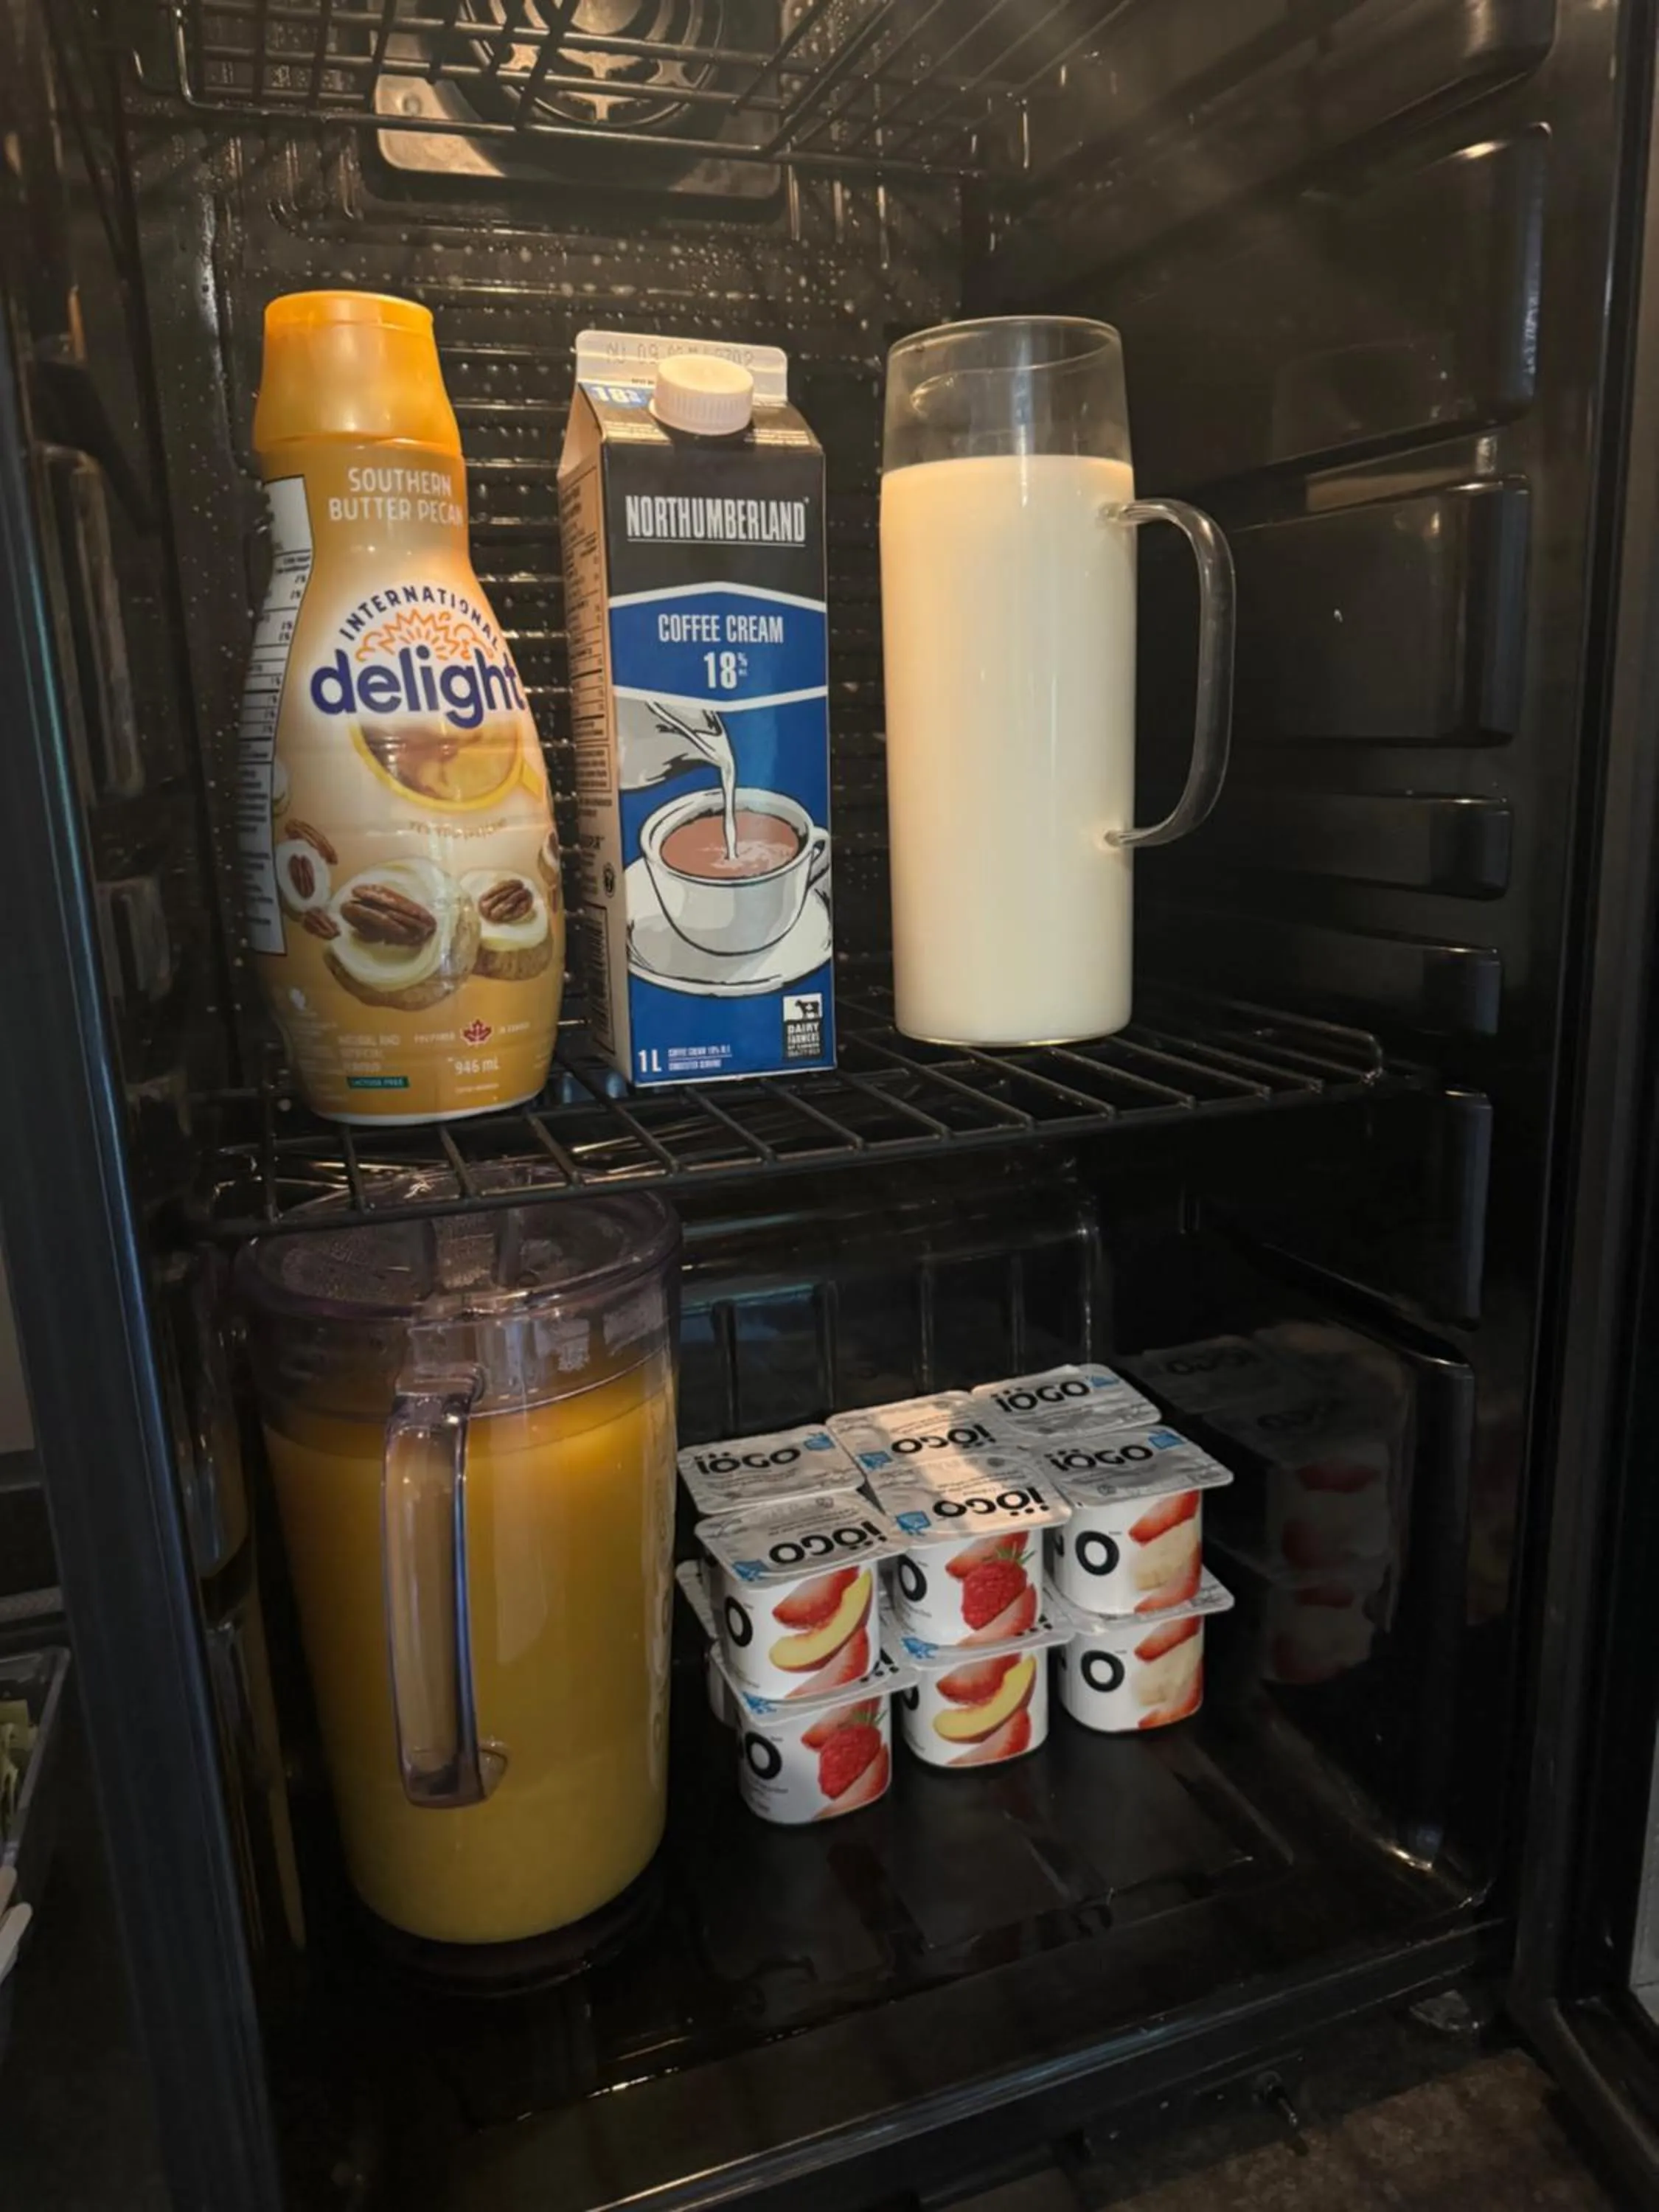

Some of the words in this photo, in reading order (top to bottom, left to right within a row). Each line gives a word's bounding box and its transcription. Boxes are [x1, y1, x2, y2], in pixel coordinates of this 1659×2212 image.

[348, 467, 451, 496] SOUTHERN
[329, 497, 411, 521] BUTTER
[417, 499, 463, 527] PECAN
[625, 495, 806, 543] NORTHUMBERLAND
[339, 585, 498, 651] INTERNATIONAL
[658, 614, 720, 643] COFFEE
[726, 615, 784, 644] CREAM
[310, 644, 526, 728] delight
